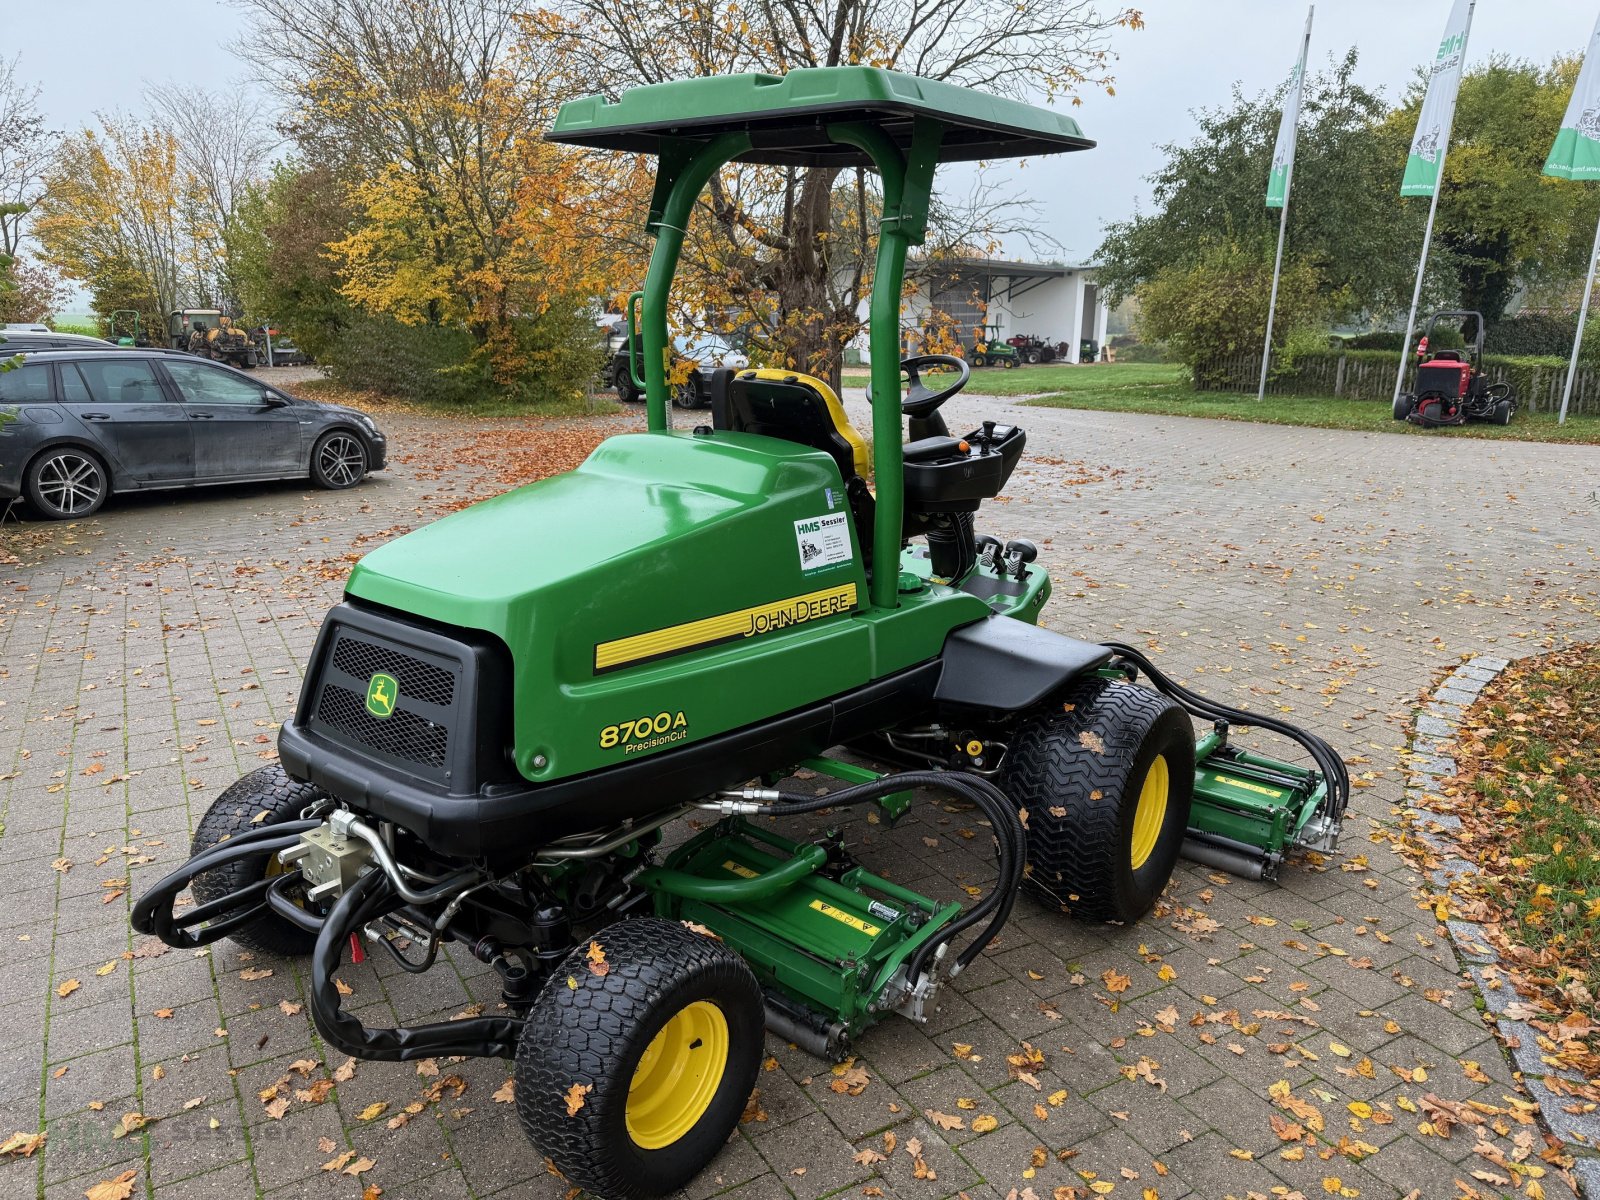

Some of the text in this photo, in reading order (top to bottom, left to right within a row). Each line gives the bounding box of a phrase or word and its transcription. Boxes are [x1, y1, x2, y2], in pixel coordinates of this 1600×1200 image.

[797, 521, 820, 535] HMS
[821, 516, 845, 527] Sessler
[743, 592, 850, 637] JOHN DEERE
[624, 729, 688, 755] PrecisionCut
